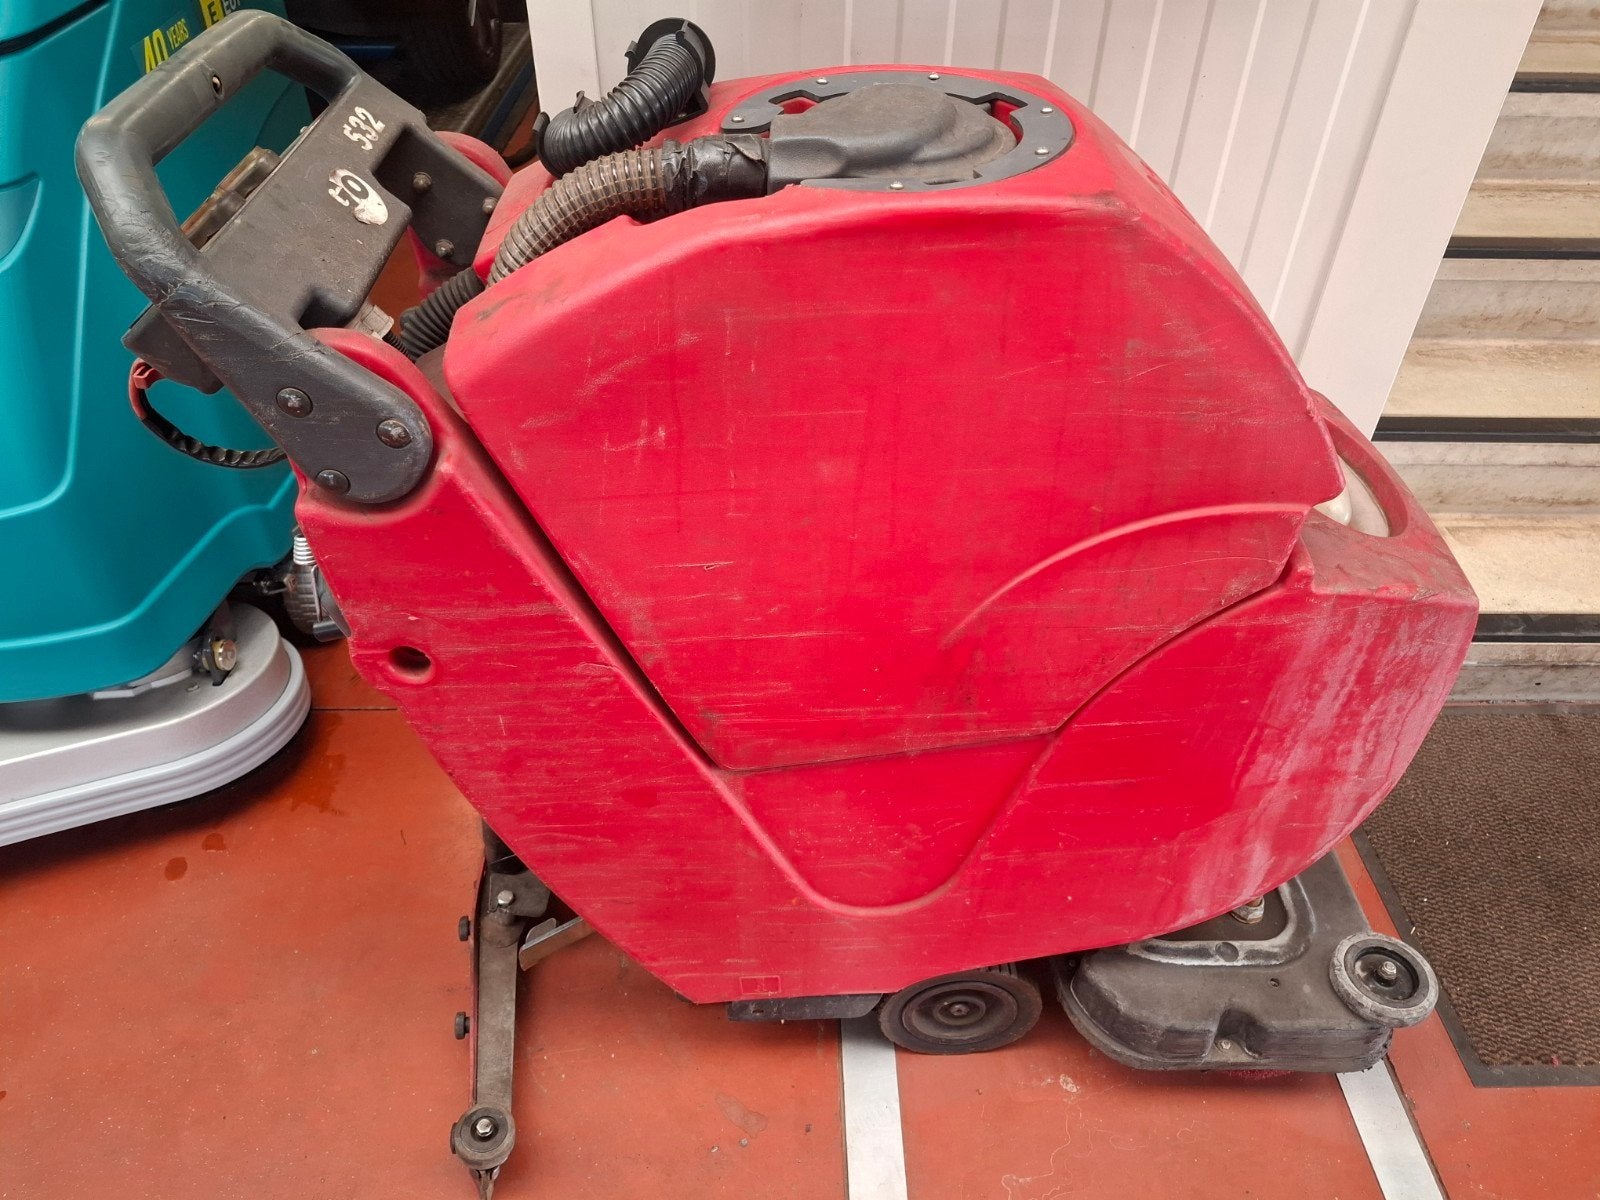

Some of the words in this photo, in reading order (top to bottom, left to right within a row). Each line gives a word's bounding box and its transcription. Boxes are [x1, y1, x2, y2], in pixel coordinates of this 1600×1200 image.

[144, 29, 169, 74] 40
[167, 18, 189, 50] YEARS
[343, 106, 386, 151] 532
